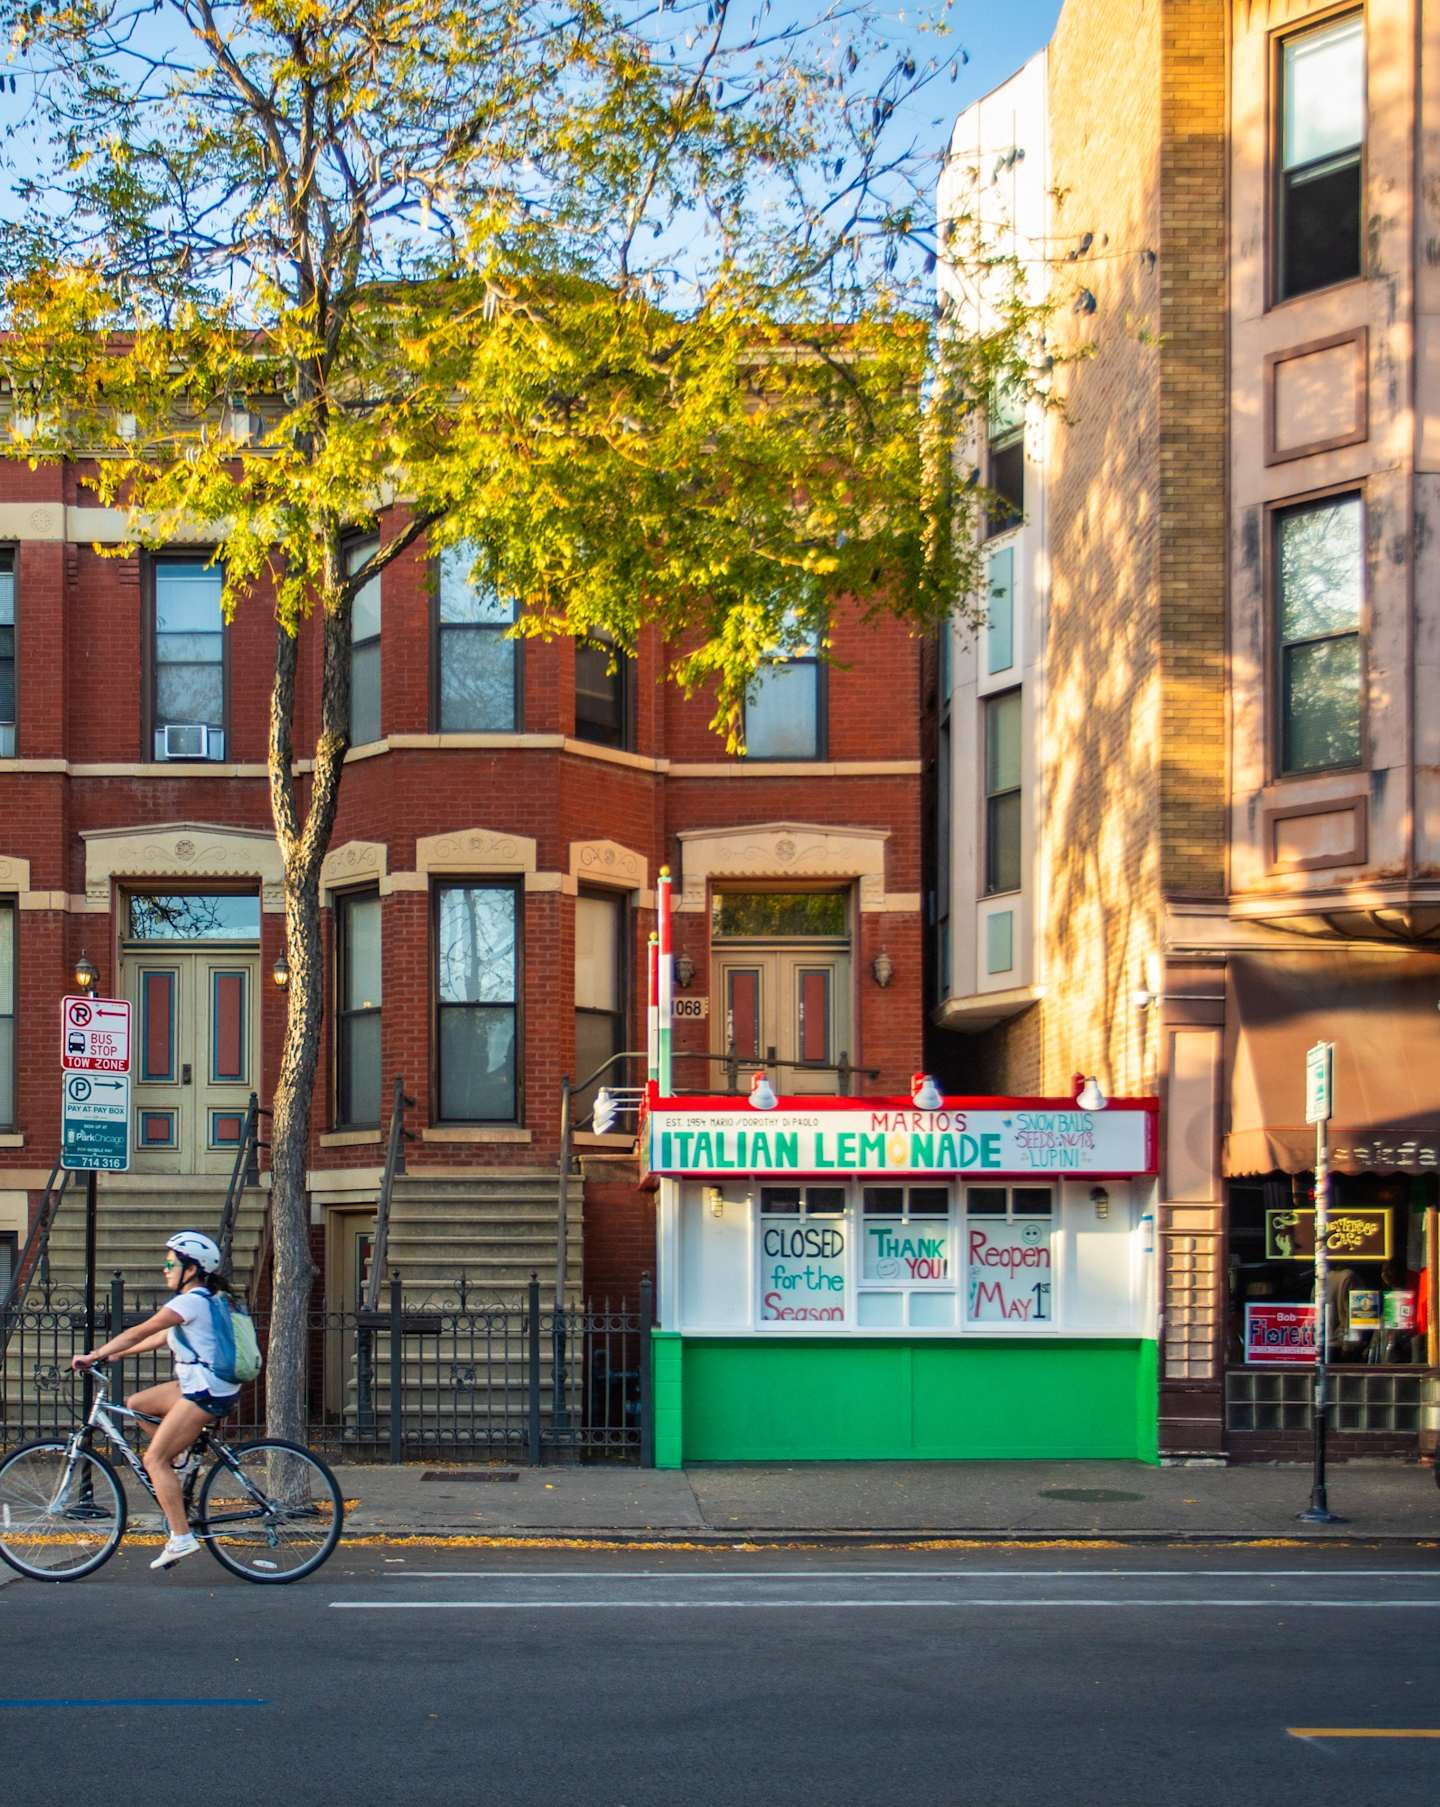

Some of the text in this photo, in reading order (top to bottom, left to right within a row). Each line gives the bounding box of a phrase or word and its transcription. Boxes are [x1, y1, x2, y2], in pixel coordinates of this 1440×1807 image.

[91, 1033, 112, 1045] BUS
[91, 1045, 117, 1057] STOP
[67, 1056, 125, 1071] TOW ZONE
[661, 1132, 1002, 1168] ITALIAN LEMONADE
[1028, 1148, 1080, 1168] LUPINI
[81, 1157, 99, 1167] 714
[102, 1158, 120, 1168] 316
[763, 1229, 845, 1258] CLOSED
[968, 1230, 1051, 1280] Reopen
[771, 1264, 844, 1292] for the
[904, 1257, 949, 1280] YOU!
[763, 1292, 844, 1321] Season
[1276, 1312, 1297, 1322] Bob
